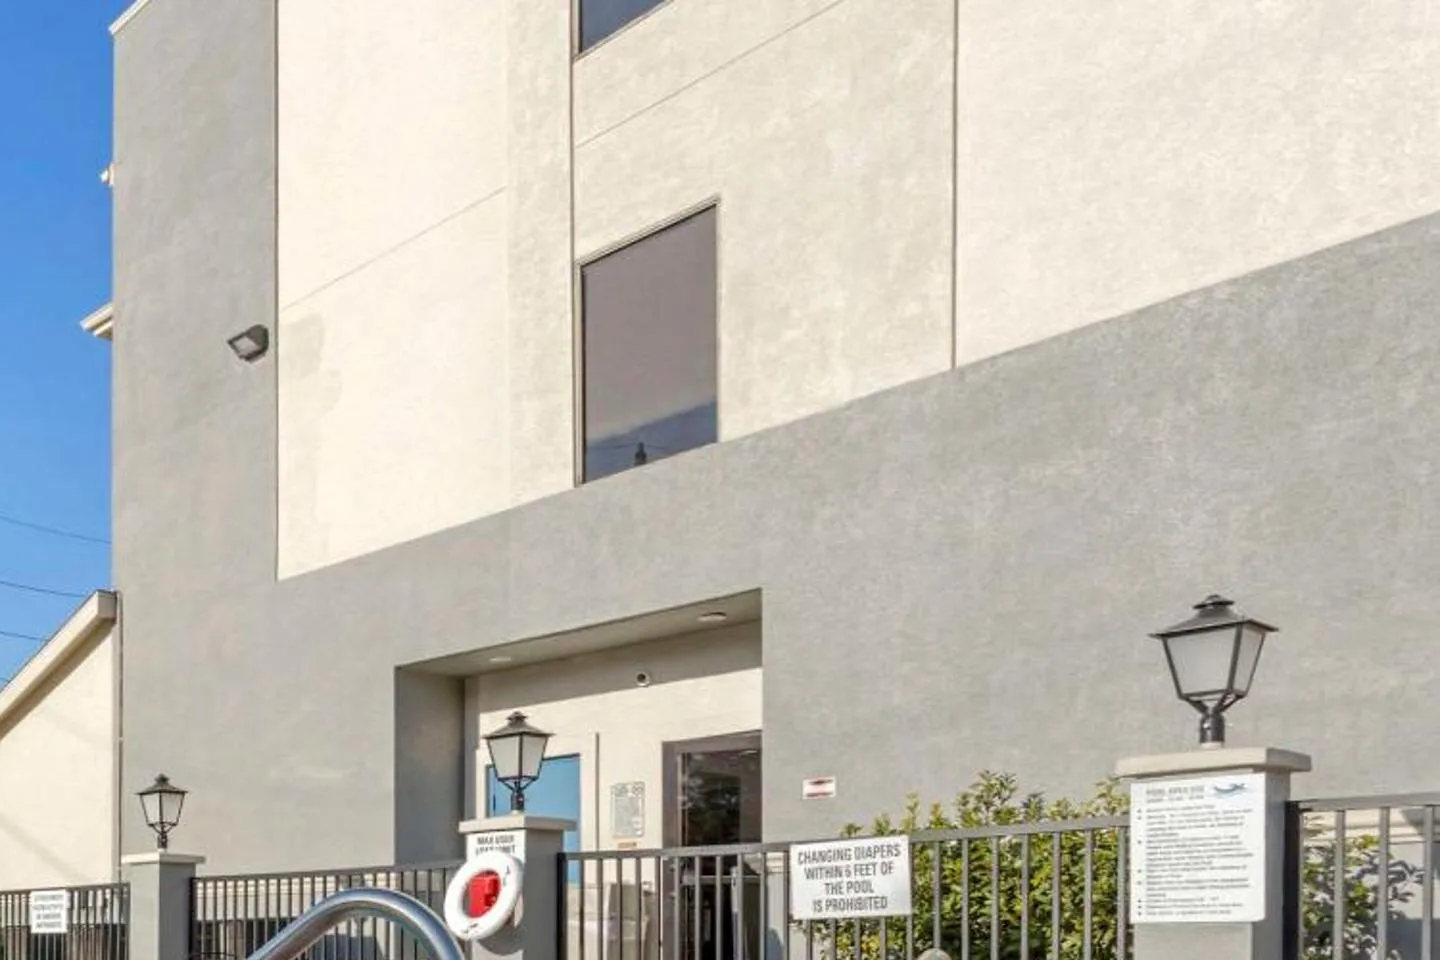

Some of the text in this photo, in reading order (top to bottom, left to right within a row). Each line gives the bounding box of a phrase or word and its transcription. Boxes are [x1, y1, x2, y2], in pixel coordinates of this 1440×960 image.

[798, 844, 901, 865] CHANGING DIAPERS
[804, 861, 894, 880] WITHIN 6 FEET OF
[824, 880, 875, 895] THE POOL
[813, 896, 888, 913] IS PROHIBITED
